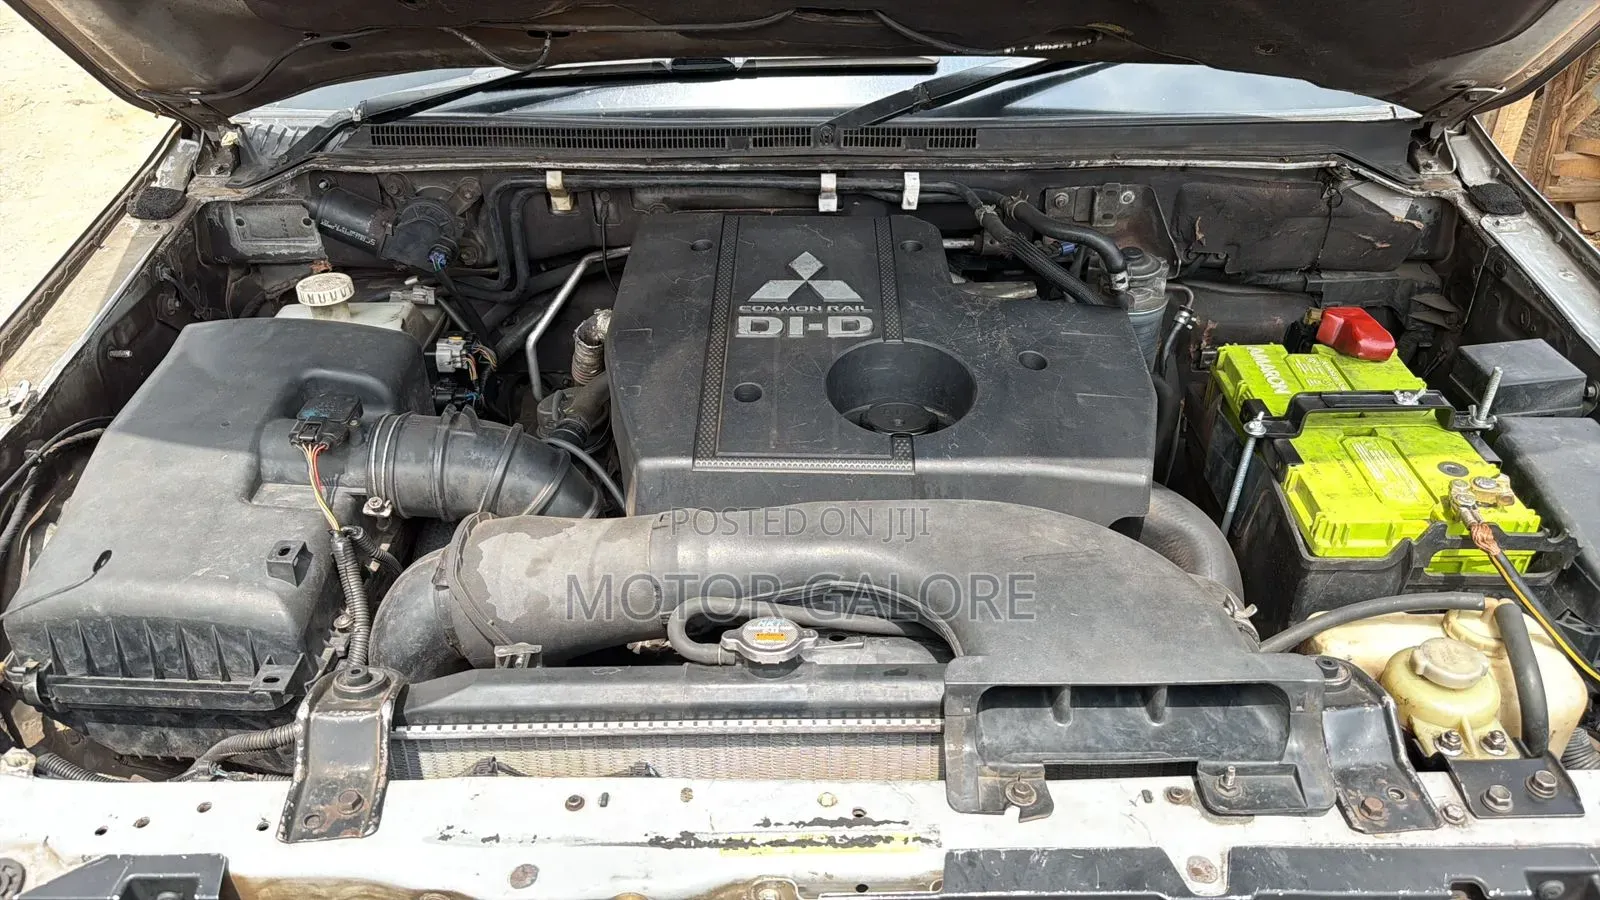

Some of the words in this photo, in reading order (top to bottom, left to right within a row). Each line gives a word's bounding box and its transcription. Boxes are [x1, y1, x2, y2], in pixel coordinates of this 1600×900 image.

[738, 305, 822, 313] COMMON
[827, 305, 874, 313] RAIL
[735, 315, 874, 338] DI-D
[1246, 346, 1292, 394] AMARON
